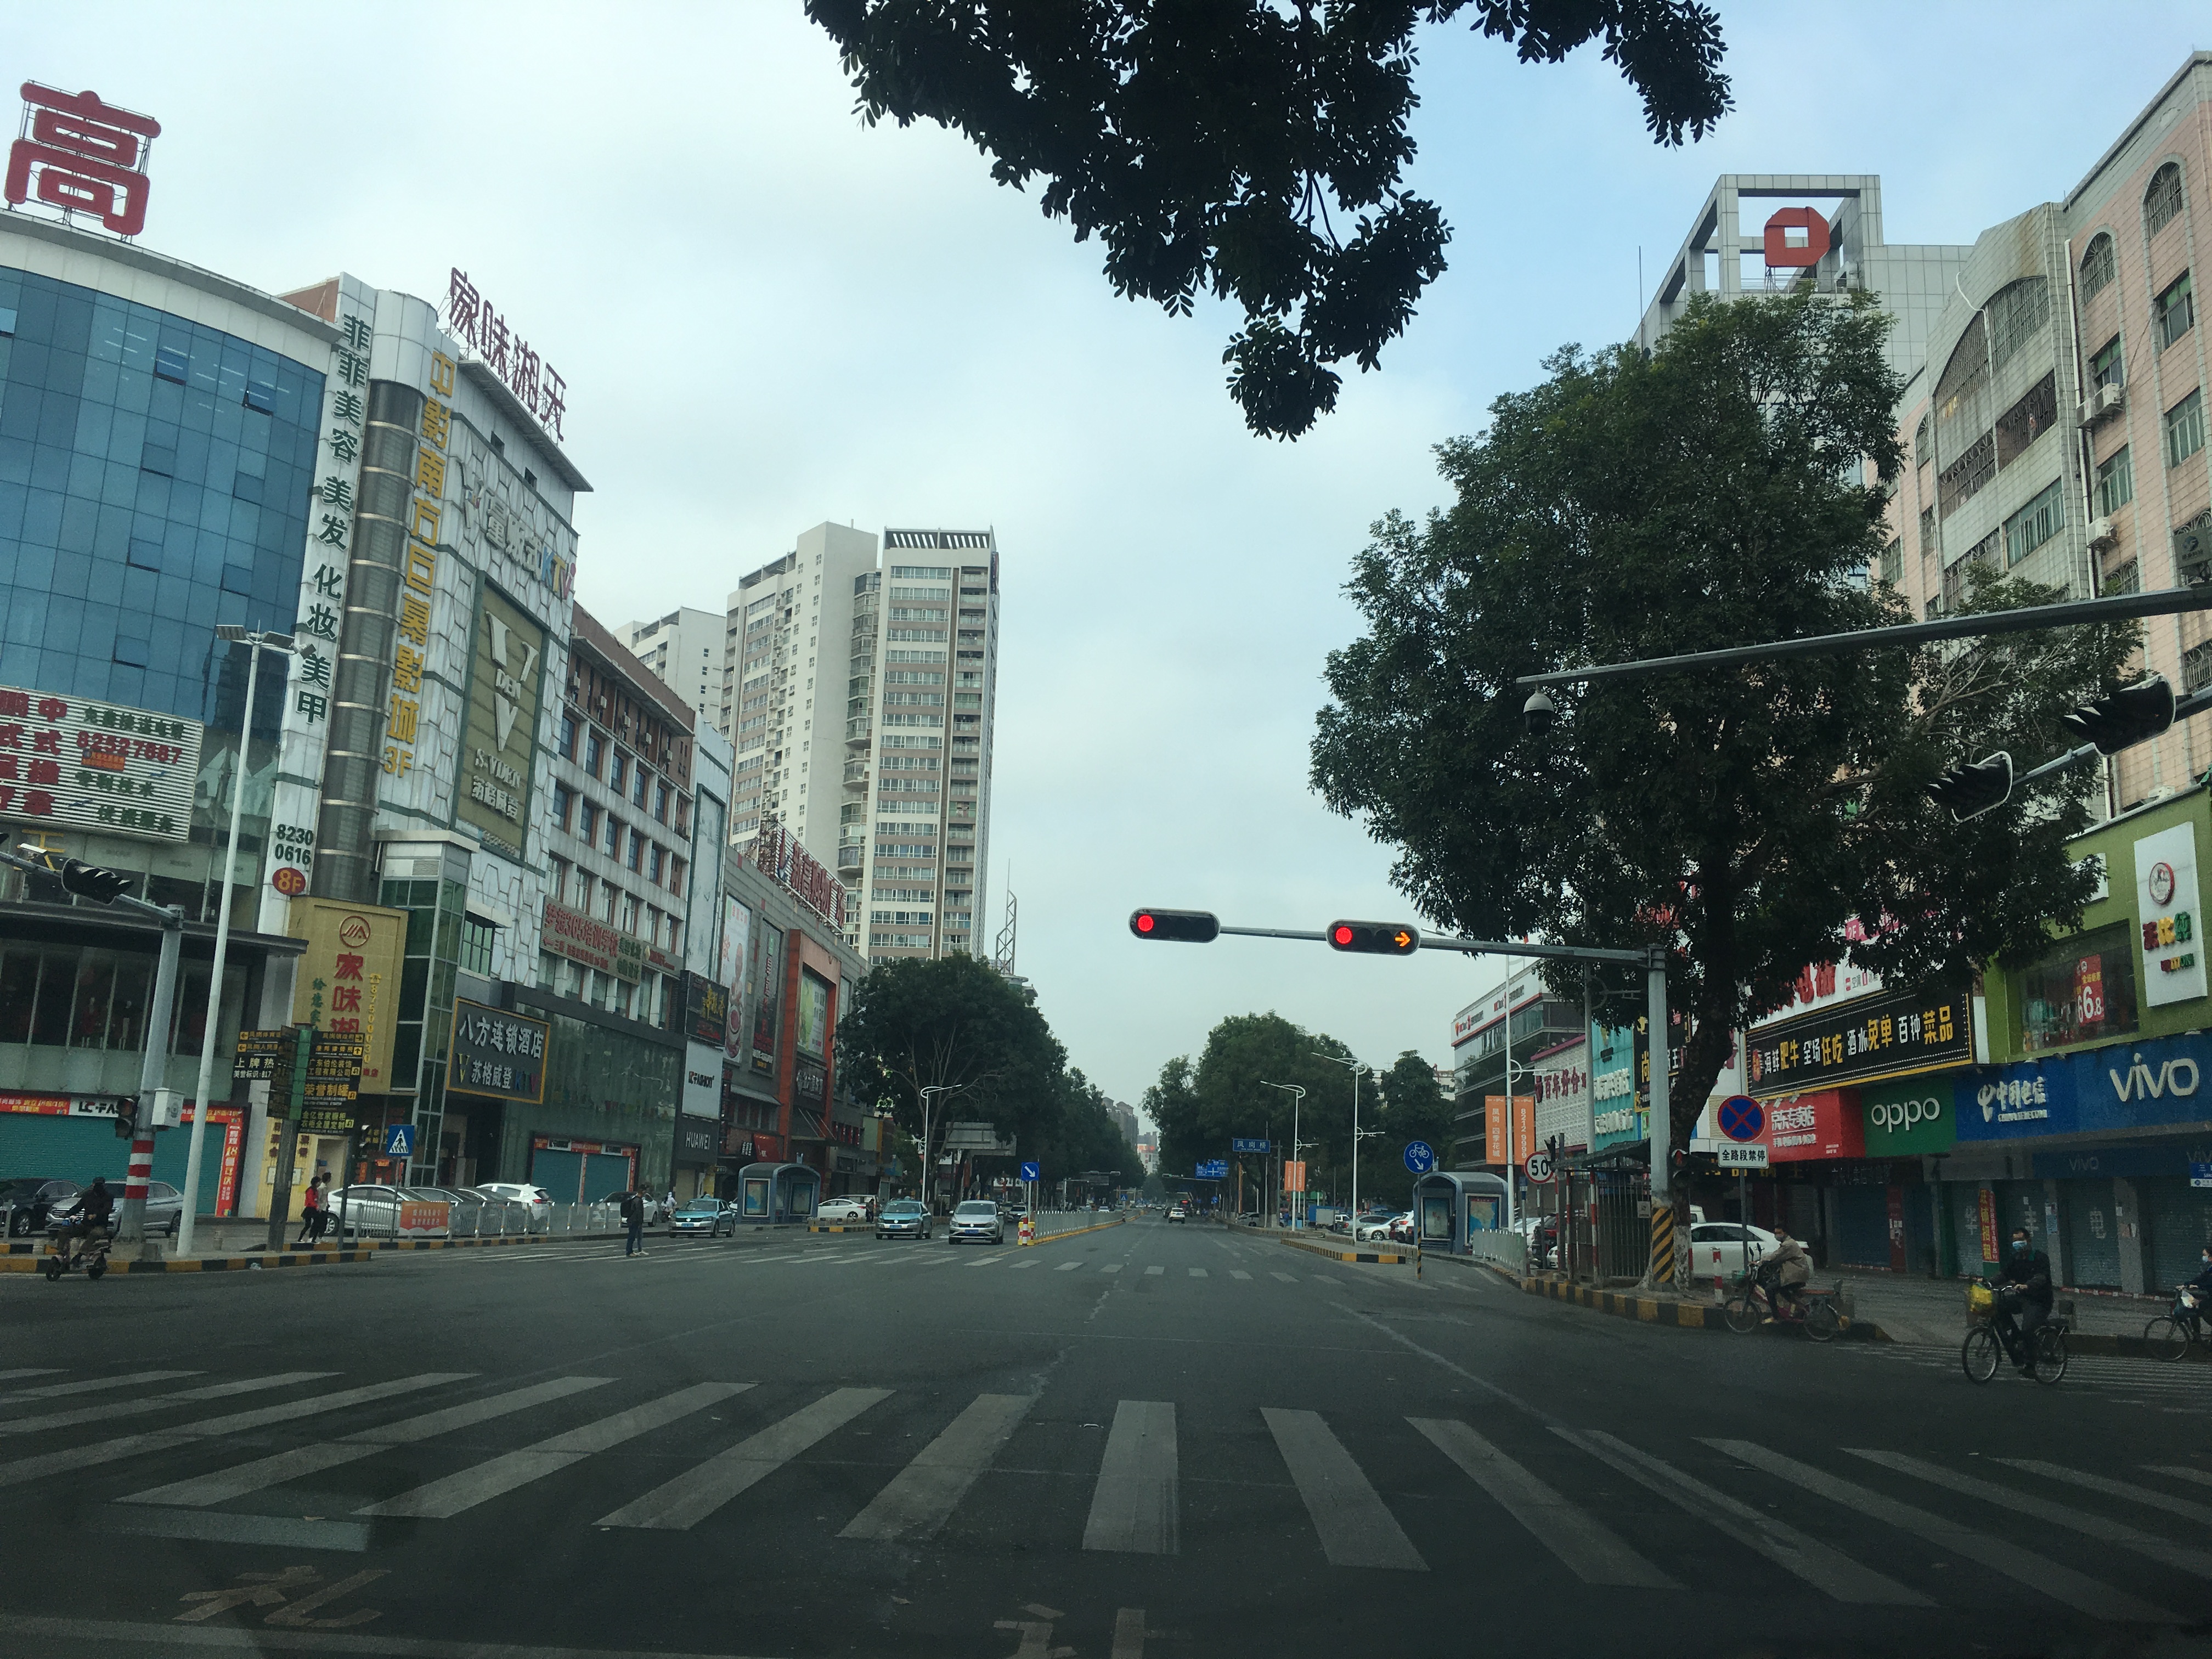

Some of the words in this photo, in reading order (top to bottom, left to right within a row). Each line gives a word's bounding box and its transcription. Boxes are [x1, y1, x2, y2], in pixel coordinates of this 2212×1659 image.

[4, 82, 161, 236] 高
[449, 267, 566, 442] 家味湘天
[385, 746, 413, 778] 3F
[276, 824, 313, 845] 8230
[275, 844, 311, 865] 0616
[278, 870, 301, 893] 8F
[459, 1013, 544, 1059] 八方连锁酒店
[1764, 1042, 1799, 1074] 海鲜肥牛
[1803, 1034, 1843, 1066] 全场任吃
[1848, 1014, 1893, 1056] 酒水免单
[1898, 1006, 1953, 1044] 百种菜品
[2109, 1053, 2199, 1102] vivo
[1996, 1076, 2046, 1111] 中国电信
[1771, 1105, 1815, 1131] 京东专卖店
[685, 1131, 712, 1150] HUAWEI
[1722, 1149, 1766, 1161] 全路段禁停
[1531, 1159, 1550, 1177] 50
